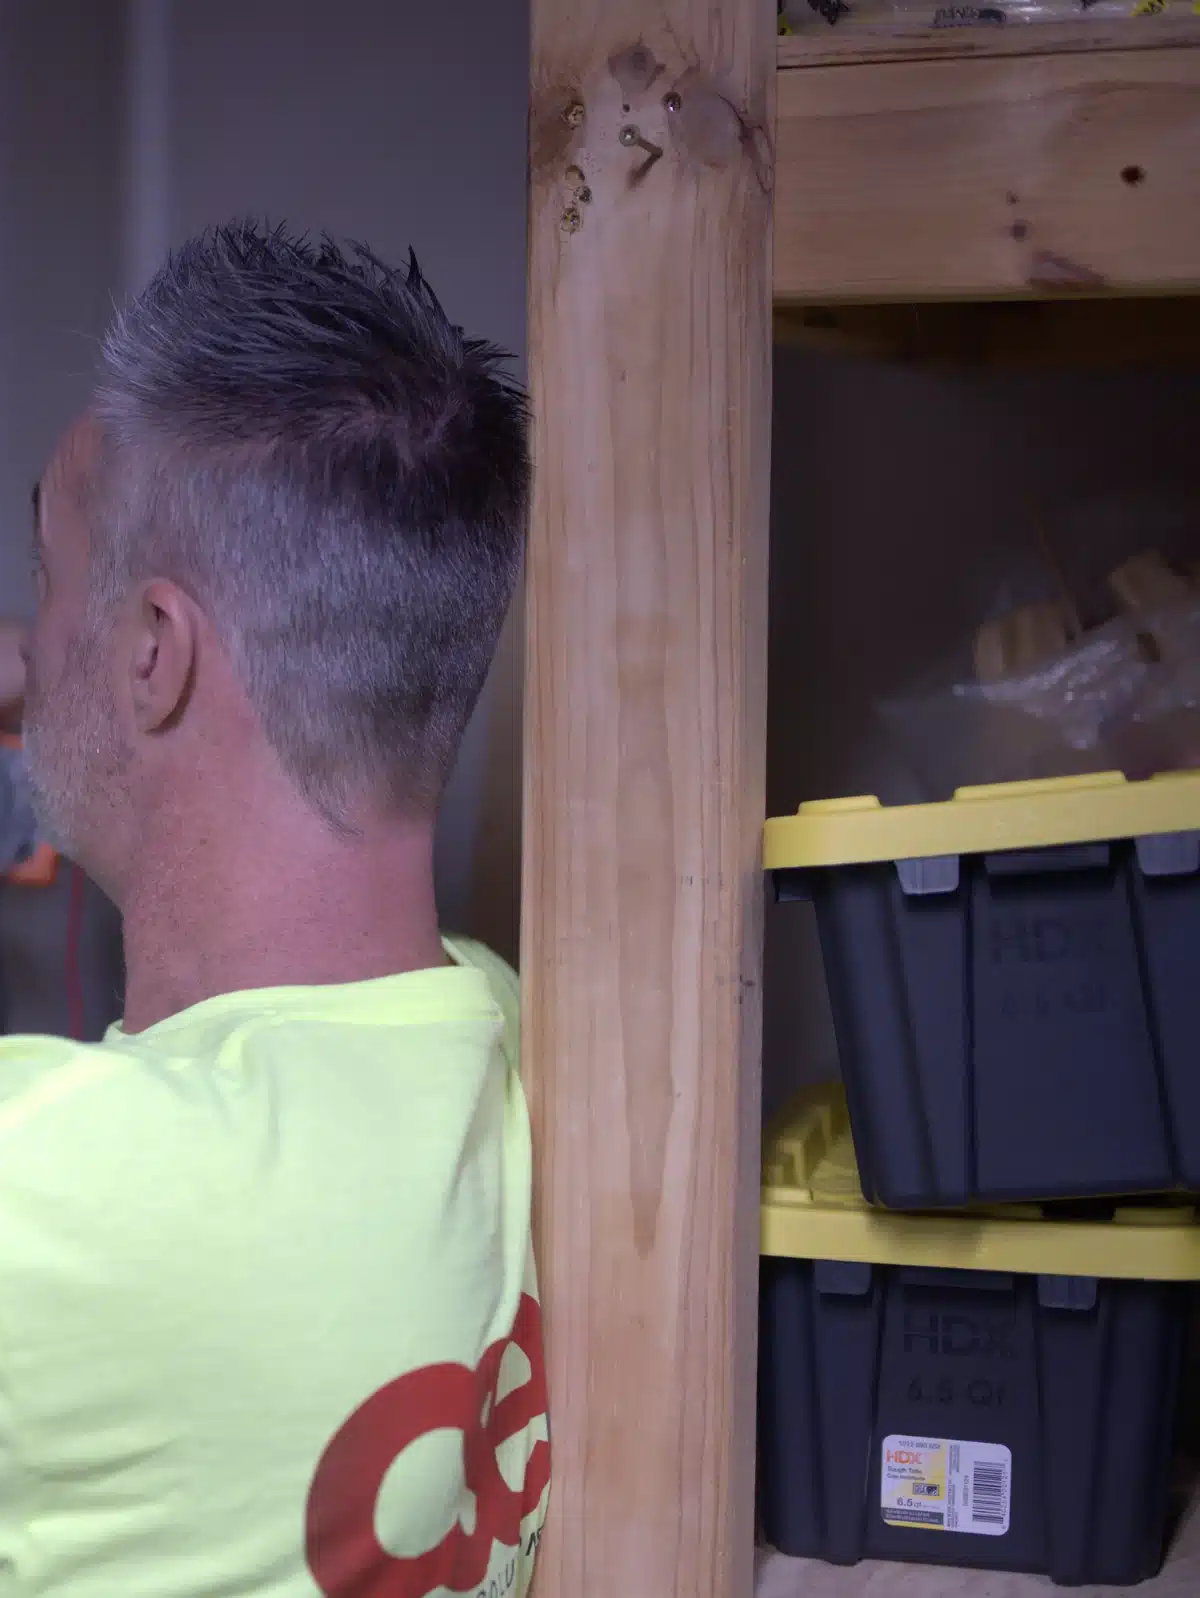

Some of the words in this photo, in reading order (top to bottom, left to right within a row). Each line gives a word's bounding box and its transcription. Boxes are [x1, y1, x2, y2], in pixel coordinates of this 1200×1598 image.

[903, 1311, 1015, 1359] HDX
[907, 1374, 953, 1406] 6.5
[886, 1449, 922, 1464] HDX
[896, 1496, 913, 1507] 6.5
